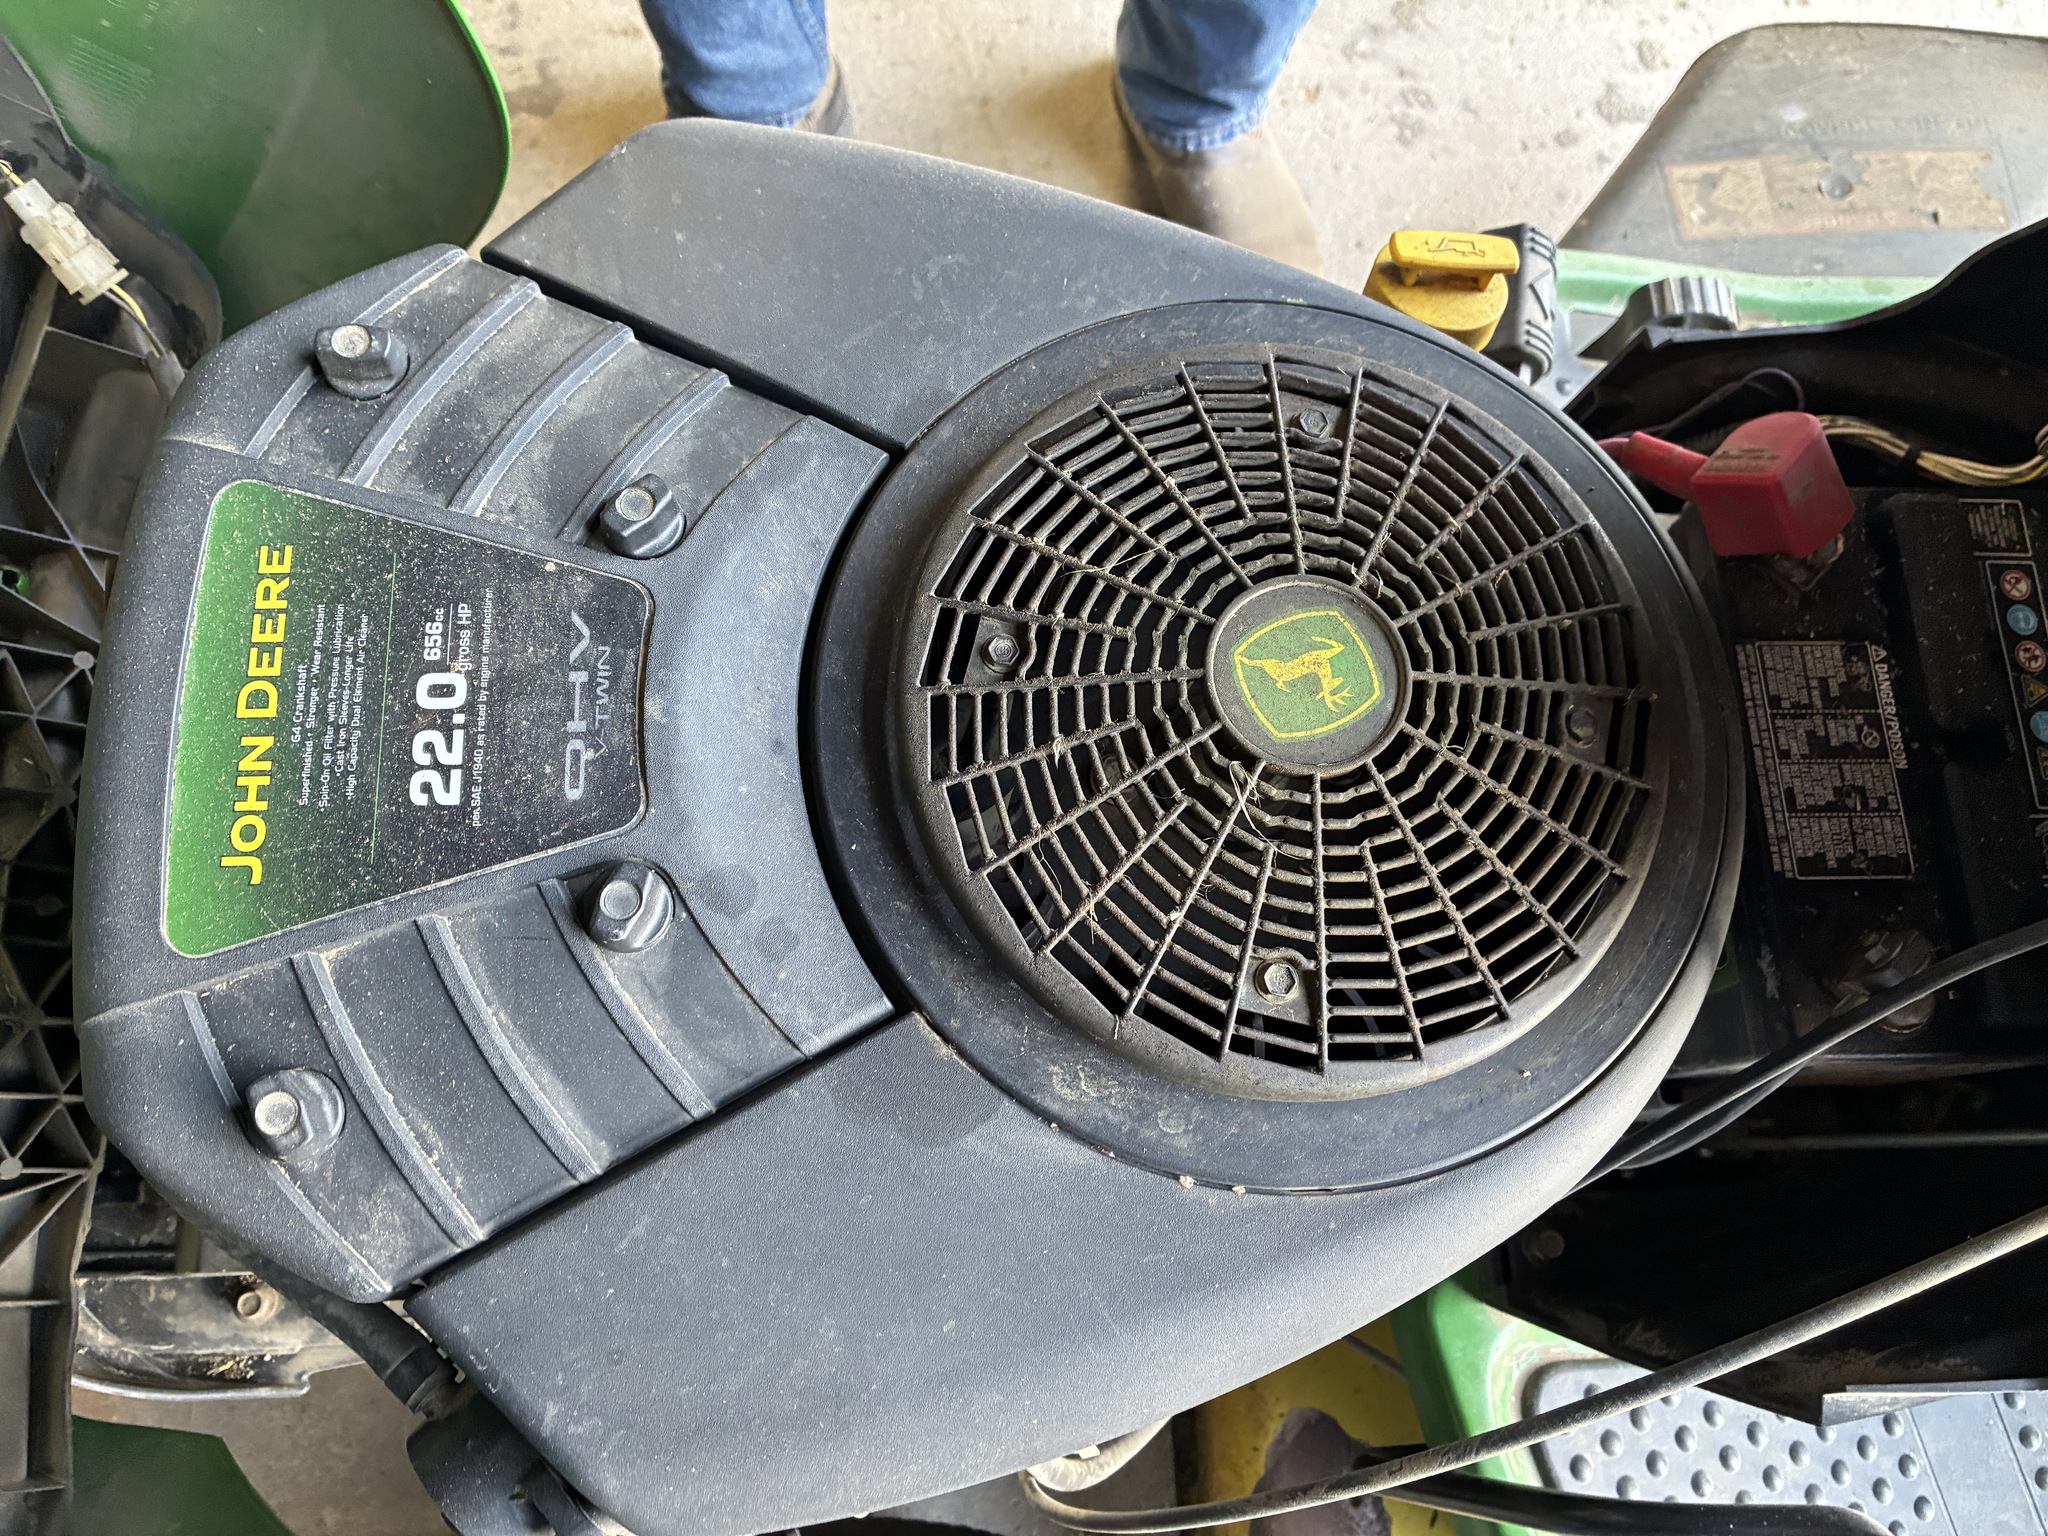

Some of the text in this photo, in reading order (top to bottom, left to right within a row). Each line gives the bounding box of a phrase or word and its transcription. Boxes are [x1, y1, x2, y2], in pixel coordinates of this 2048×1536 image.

[332, 604, 344, 654] Lubrication
[357, 614, 368, 647] Cleaner
[423, 608, 444, 661] 656cc
[457, 603, 472, 670] gross HP
[482, 588, 493, 653] manufacturer
[345, 636, 354, 652] Life
[356, 650, 365, 664] Air
[328, 657, 340, 698] Pressure
[353, 667, 364, 702] Element
[479, 656, 491, 687] engine
[291, 664, 307, 742] G4 Crankshaft
[299, 604, 325, 805] Superfinished Stronger Wear Resistant
[339, 656, 353, 725] Sleeves-Longer
[477, 690, 489, 701] by
[564, 609, 591, 800] OHV
[594, 646, 611, 758] V-TWIN
[220, 545, 294, 885] JOHN DEERE
[327, 701, 336, 722] with
[351, 705, 361, 726] Dual
[477, 704, 486, 731] rated
[1875, 663, 1908, 769] DANGER/POISON
[324, 725, 334, 750] Filter
[337, 728, 346, 746] Iron
[348, 730, 360, 771] Capacity
[409, 672, 467, 806] 22.0
[477, 734, 485, 746] as
[322, 753, 332, 766] Oil
[473, 749, 483, 783] J1940
[471, 785, 482, 806] SAE
